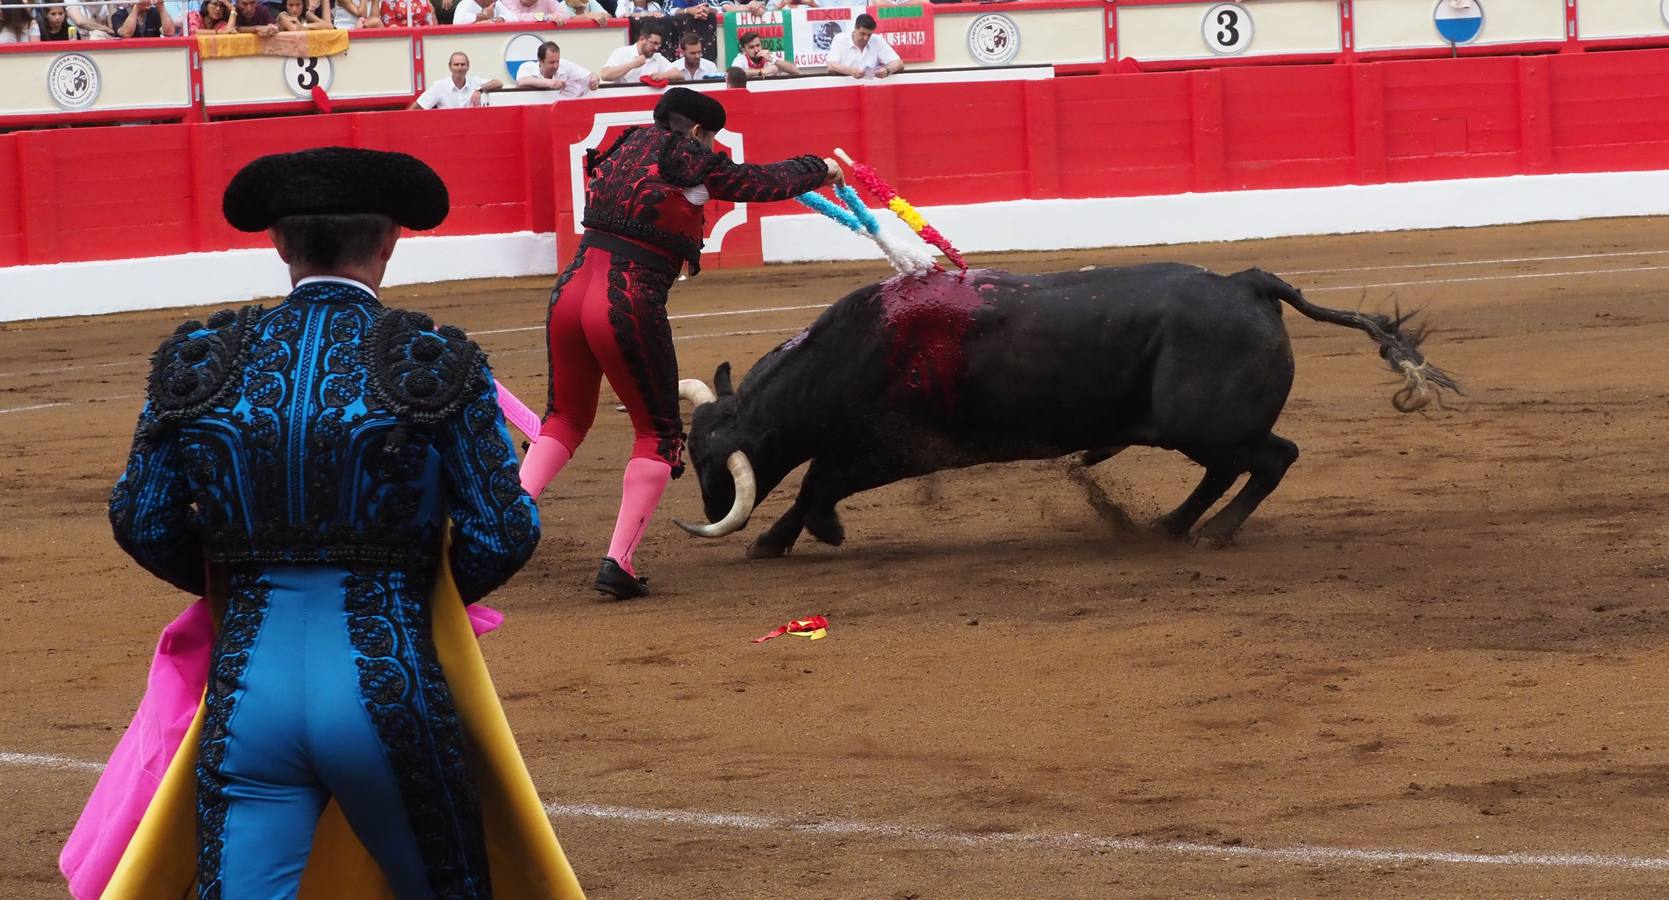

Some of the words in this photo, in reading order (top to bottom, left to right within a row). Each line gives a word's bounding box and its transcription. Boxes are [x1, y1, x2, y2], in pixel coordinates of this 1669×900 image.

[741, 12, 776, 24] HOLA
[1216, 10, 1239, 46] 3
[893, 32, 923, 45] SERNA
[297, 57, 319, 90] 3
